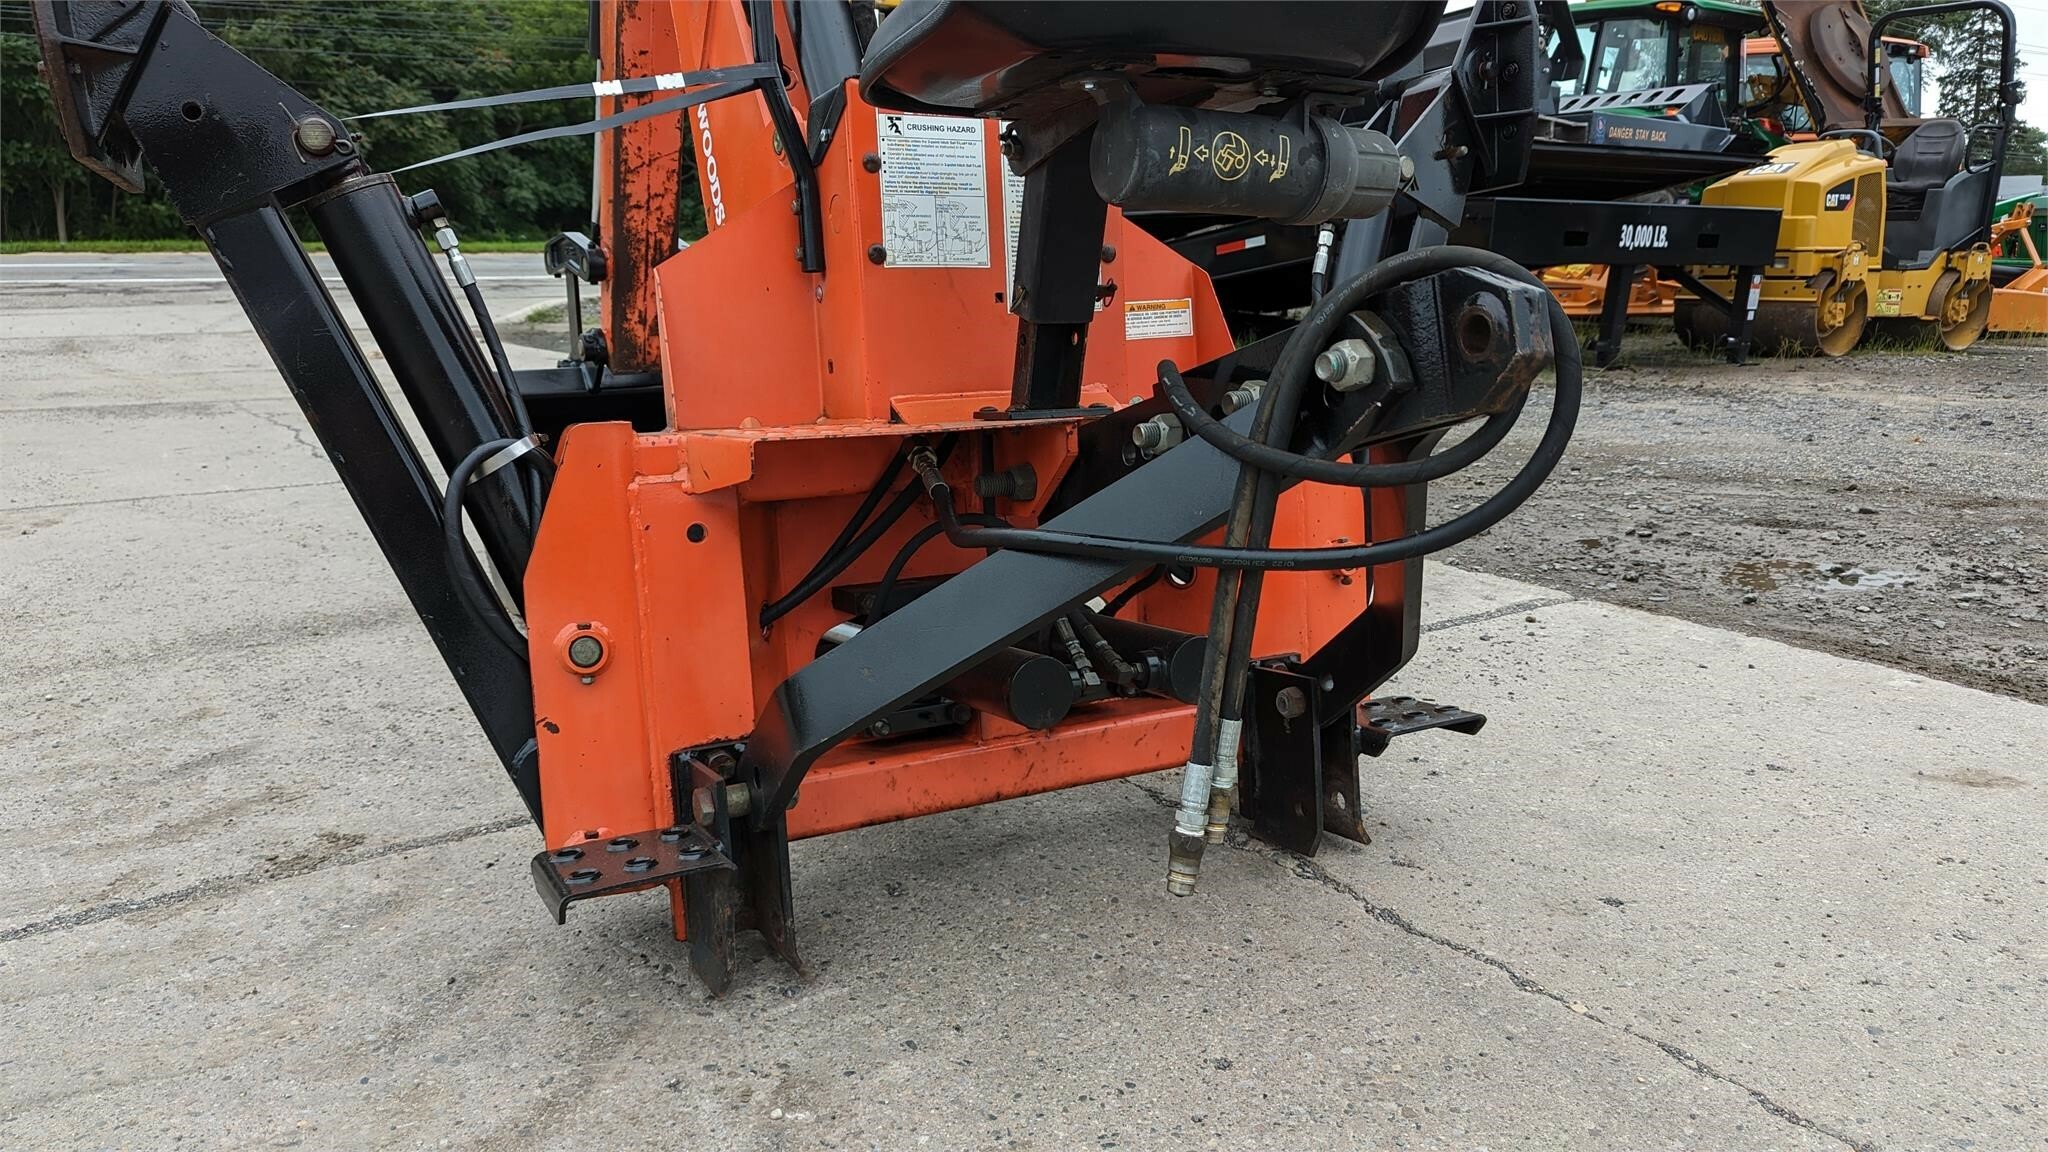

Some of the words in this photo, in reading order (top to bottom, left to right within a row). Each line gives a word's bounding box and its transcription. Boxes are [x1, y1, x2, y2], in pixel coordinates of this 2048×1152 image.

[906, 123, 945, 132] CRUSHING
[946, 125, 976, 134] HAZARD
[1609, 126, 1633, 139] DANGER
[1635, 129, 1649, 140] STAY
[1651, 130, 1666, 142] BACK
[697, 102, 725, 226] WOODS
[1748, 162, 1796, 174] CAT
[1826, 194, 1839, 207] CAT
[1618, 224, 1653, 250] 30,000
[1653, 225, 1668, 248] LB.
